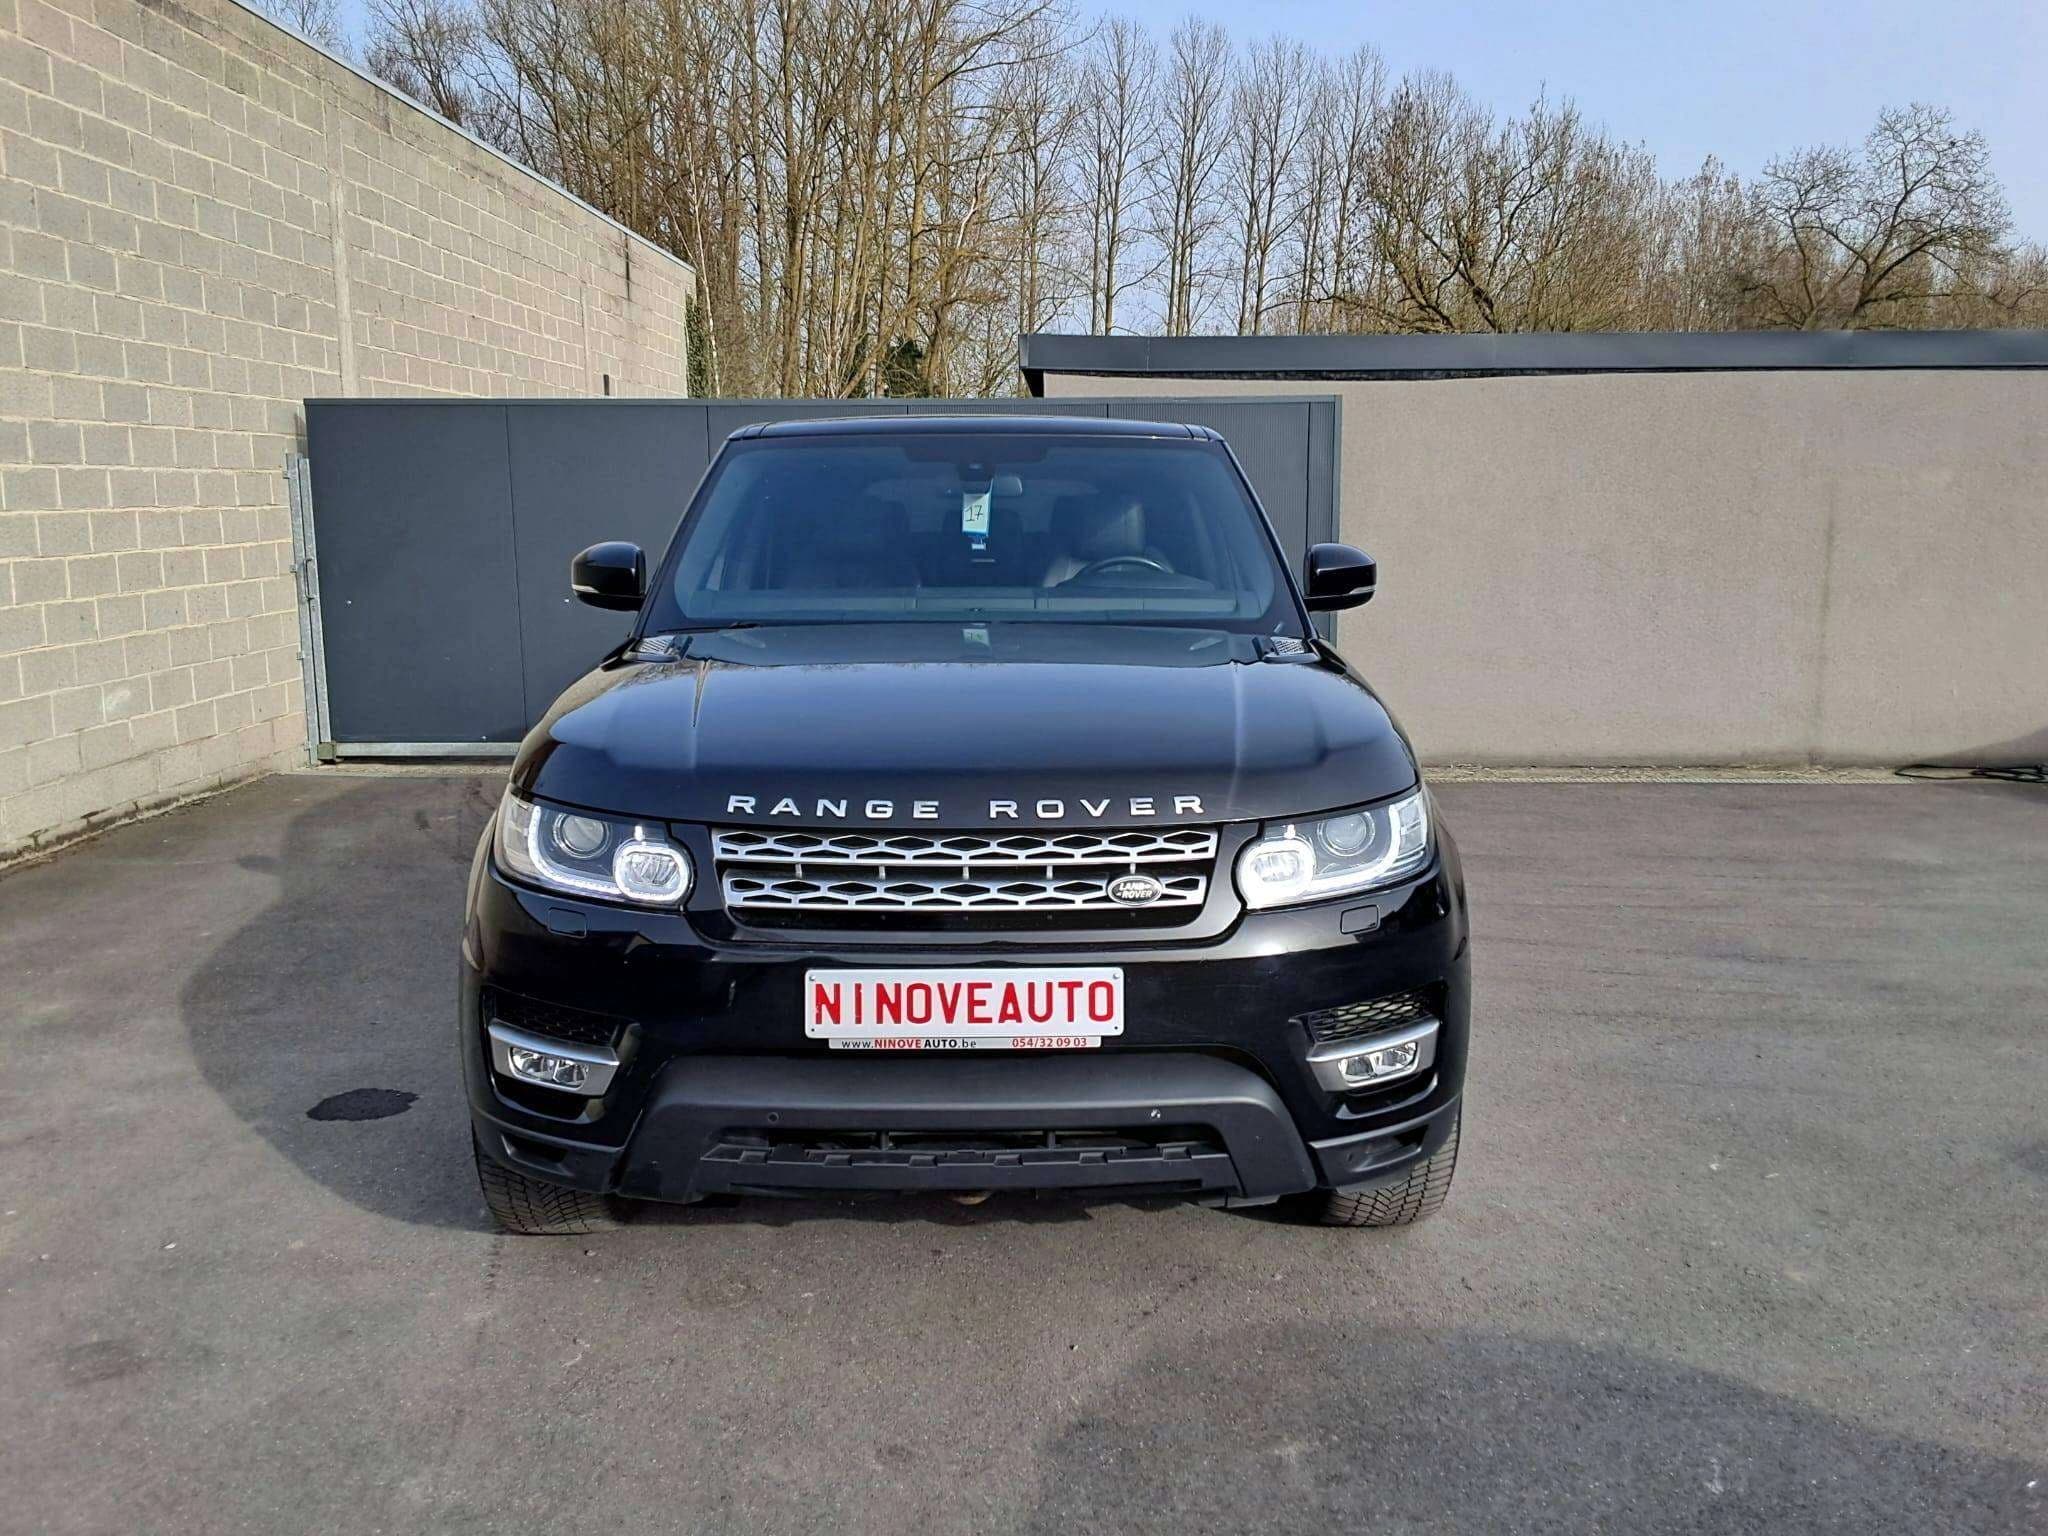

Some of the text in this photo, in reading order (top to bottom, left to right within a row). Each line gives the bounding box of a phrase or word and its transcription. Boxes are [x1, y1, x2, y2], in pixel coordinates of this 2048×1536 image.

[964, 504, 984, 522] 17
[726, 795, 1204, 819] RANGE ROVER
[1119, 882, 1146, 891] LAND
[1121, 890, 1152, 898] ROVER
[1012, 1037, 1053, 1048] 054/32
[1056, 1037, 1072, 1048] 09
[1073, 1037, 1087, 1047] 03
